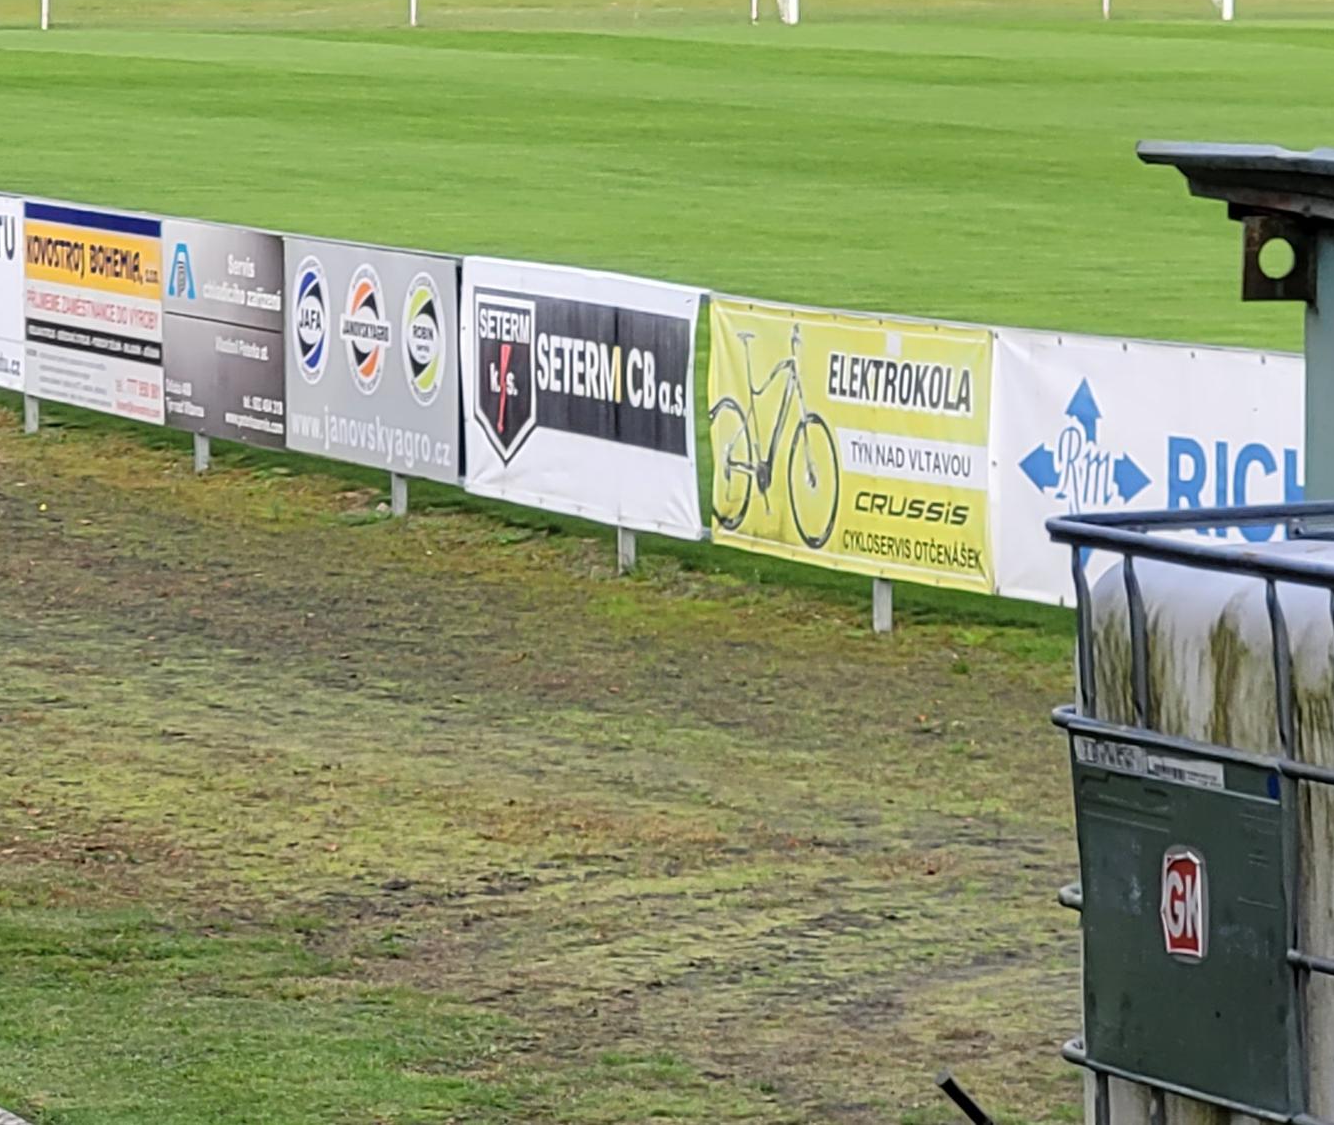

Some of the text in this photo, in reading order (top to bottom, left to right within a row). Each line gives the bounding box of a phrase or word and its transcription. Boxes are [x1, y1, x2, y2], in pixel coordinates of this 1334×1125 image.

[227, 252, 256, 279] Servis
[298, 309, 322, 332] JAFA
[479, 308, 530, 344] SETERM
[537, 332, 687, 417] SETERM CB a.s.
[828, 353, 971, 413] ELEKTROKOLA
[290, 406, 452, 468] www.janovskyagro.cz
[851, 435, 971, 477] TÝN NAD VLTAVOU
[843, 529, 982, 571] CYKLOSERVIS OTČENÁŠEK
